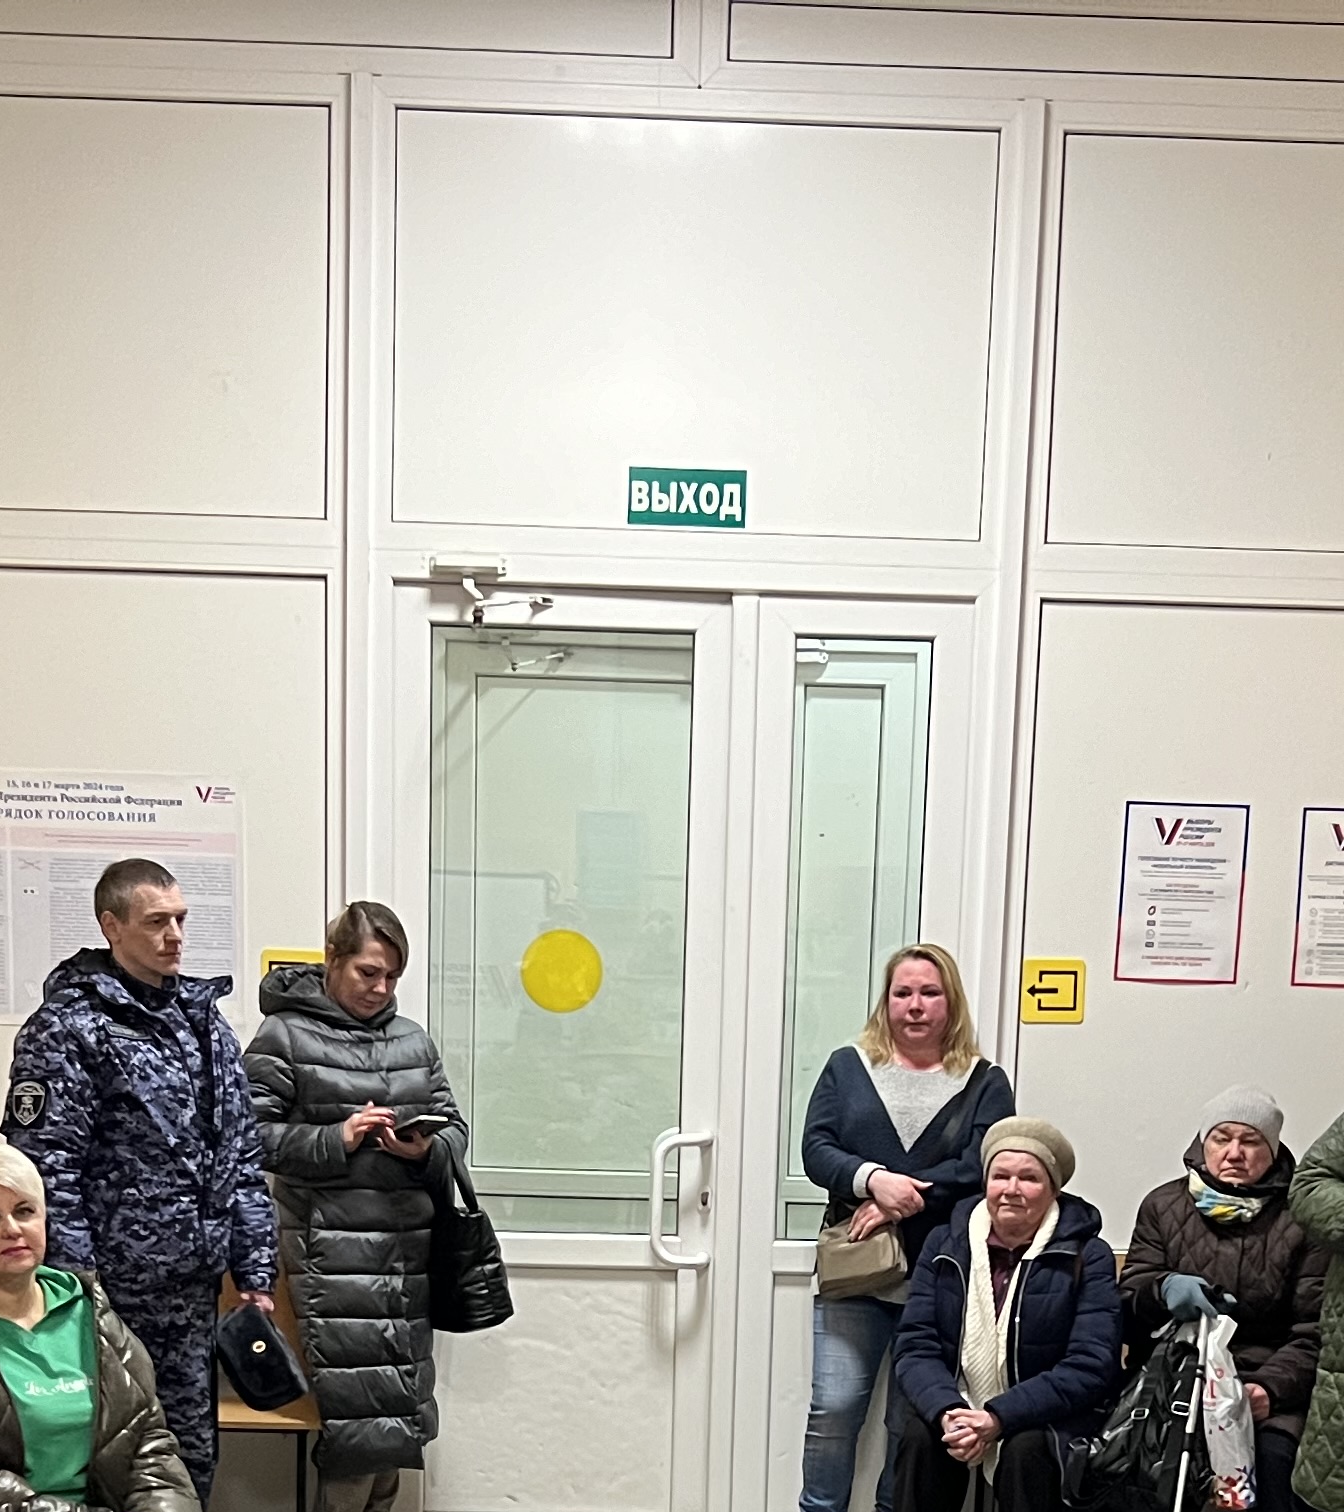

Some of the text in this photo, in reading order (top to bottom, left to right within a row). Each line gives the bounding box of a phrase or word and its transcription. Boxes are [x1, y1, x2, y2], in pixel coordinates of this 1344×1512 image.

[630, 480, 742, 522] ВЫХОД
[60, 793, 122, 804] Российской
[47, 808, 156, 822] ГОЛОСОВАНИЯ
